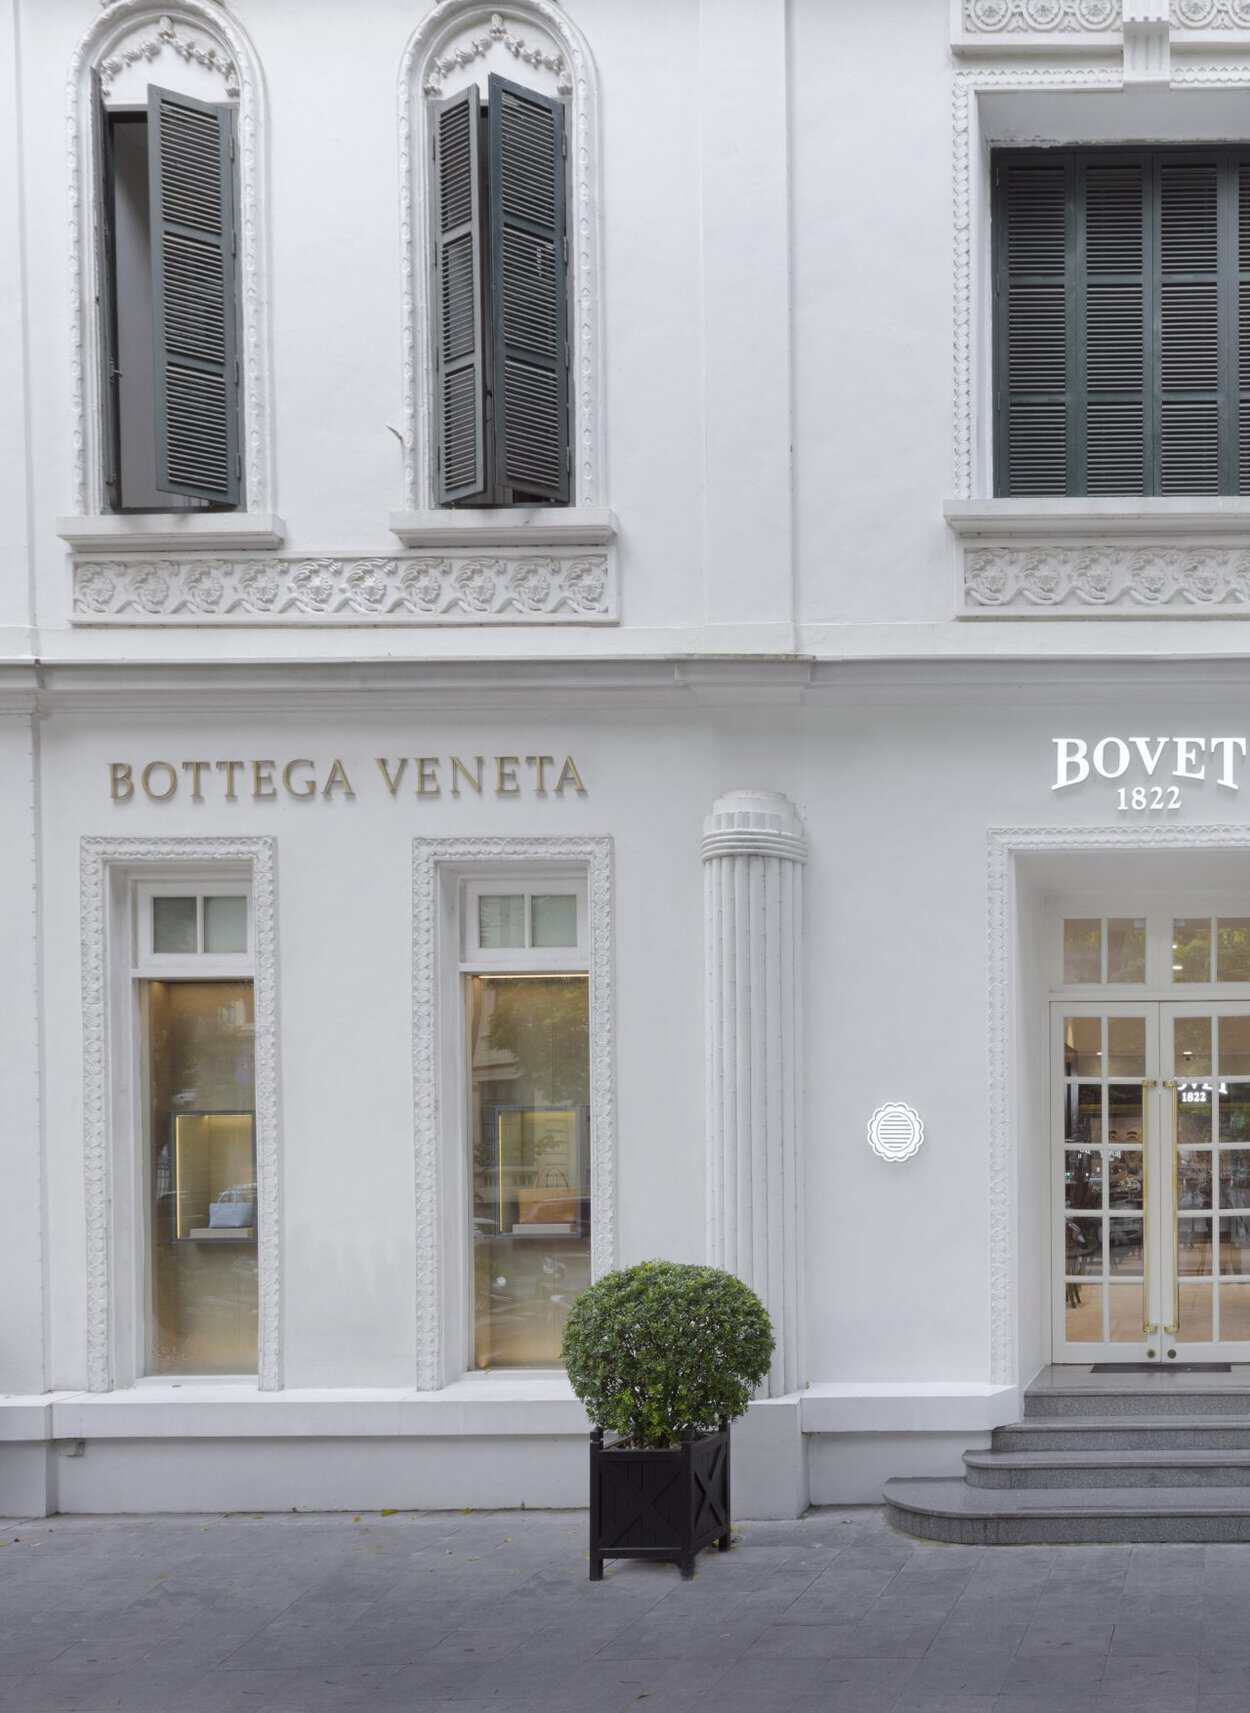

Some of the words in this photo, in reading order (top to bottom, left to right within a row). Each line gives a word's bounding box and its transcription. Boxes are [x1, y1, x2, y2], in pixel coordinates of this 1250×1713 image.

[107, 757, 357, 802] BOTTEGA
[374, 755, 590, 798] VENETA
[1051, 736, 1247, 791] BOVET
[1117, 786, 1182, 810] 1822
[1181, 1091, 1207, 1103] 1822
